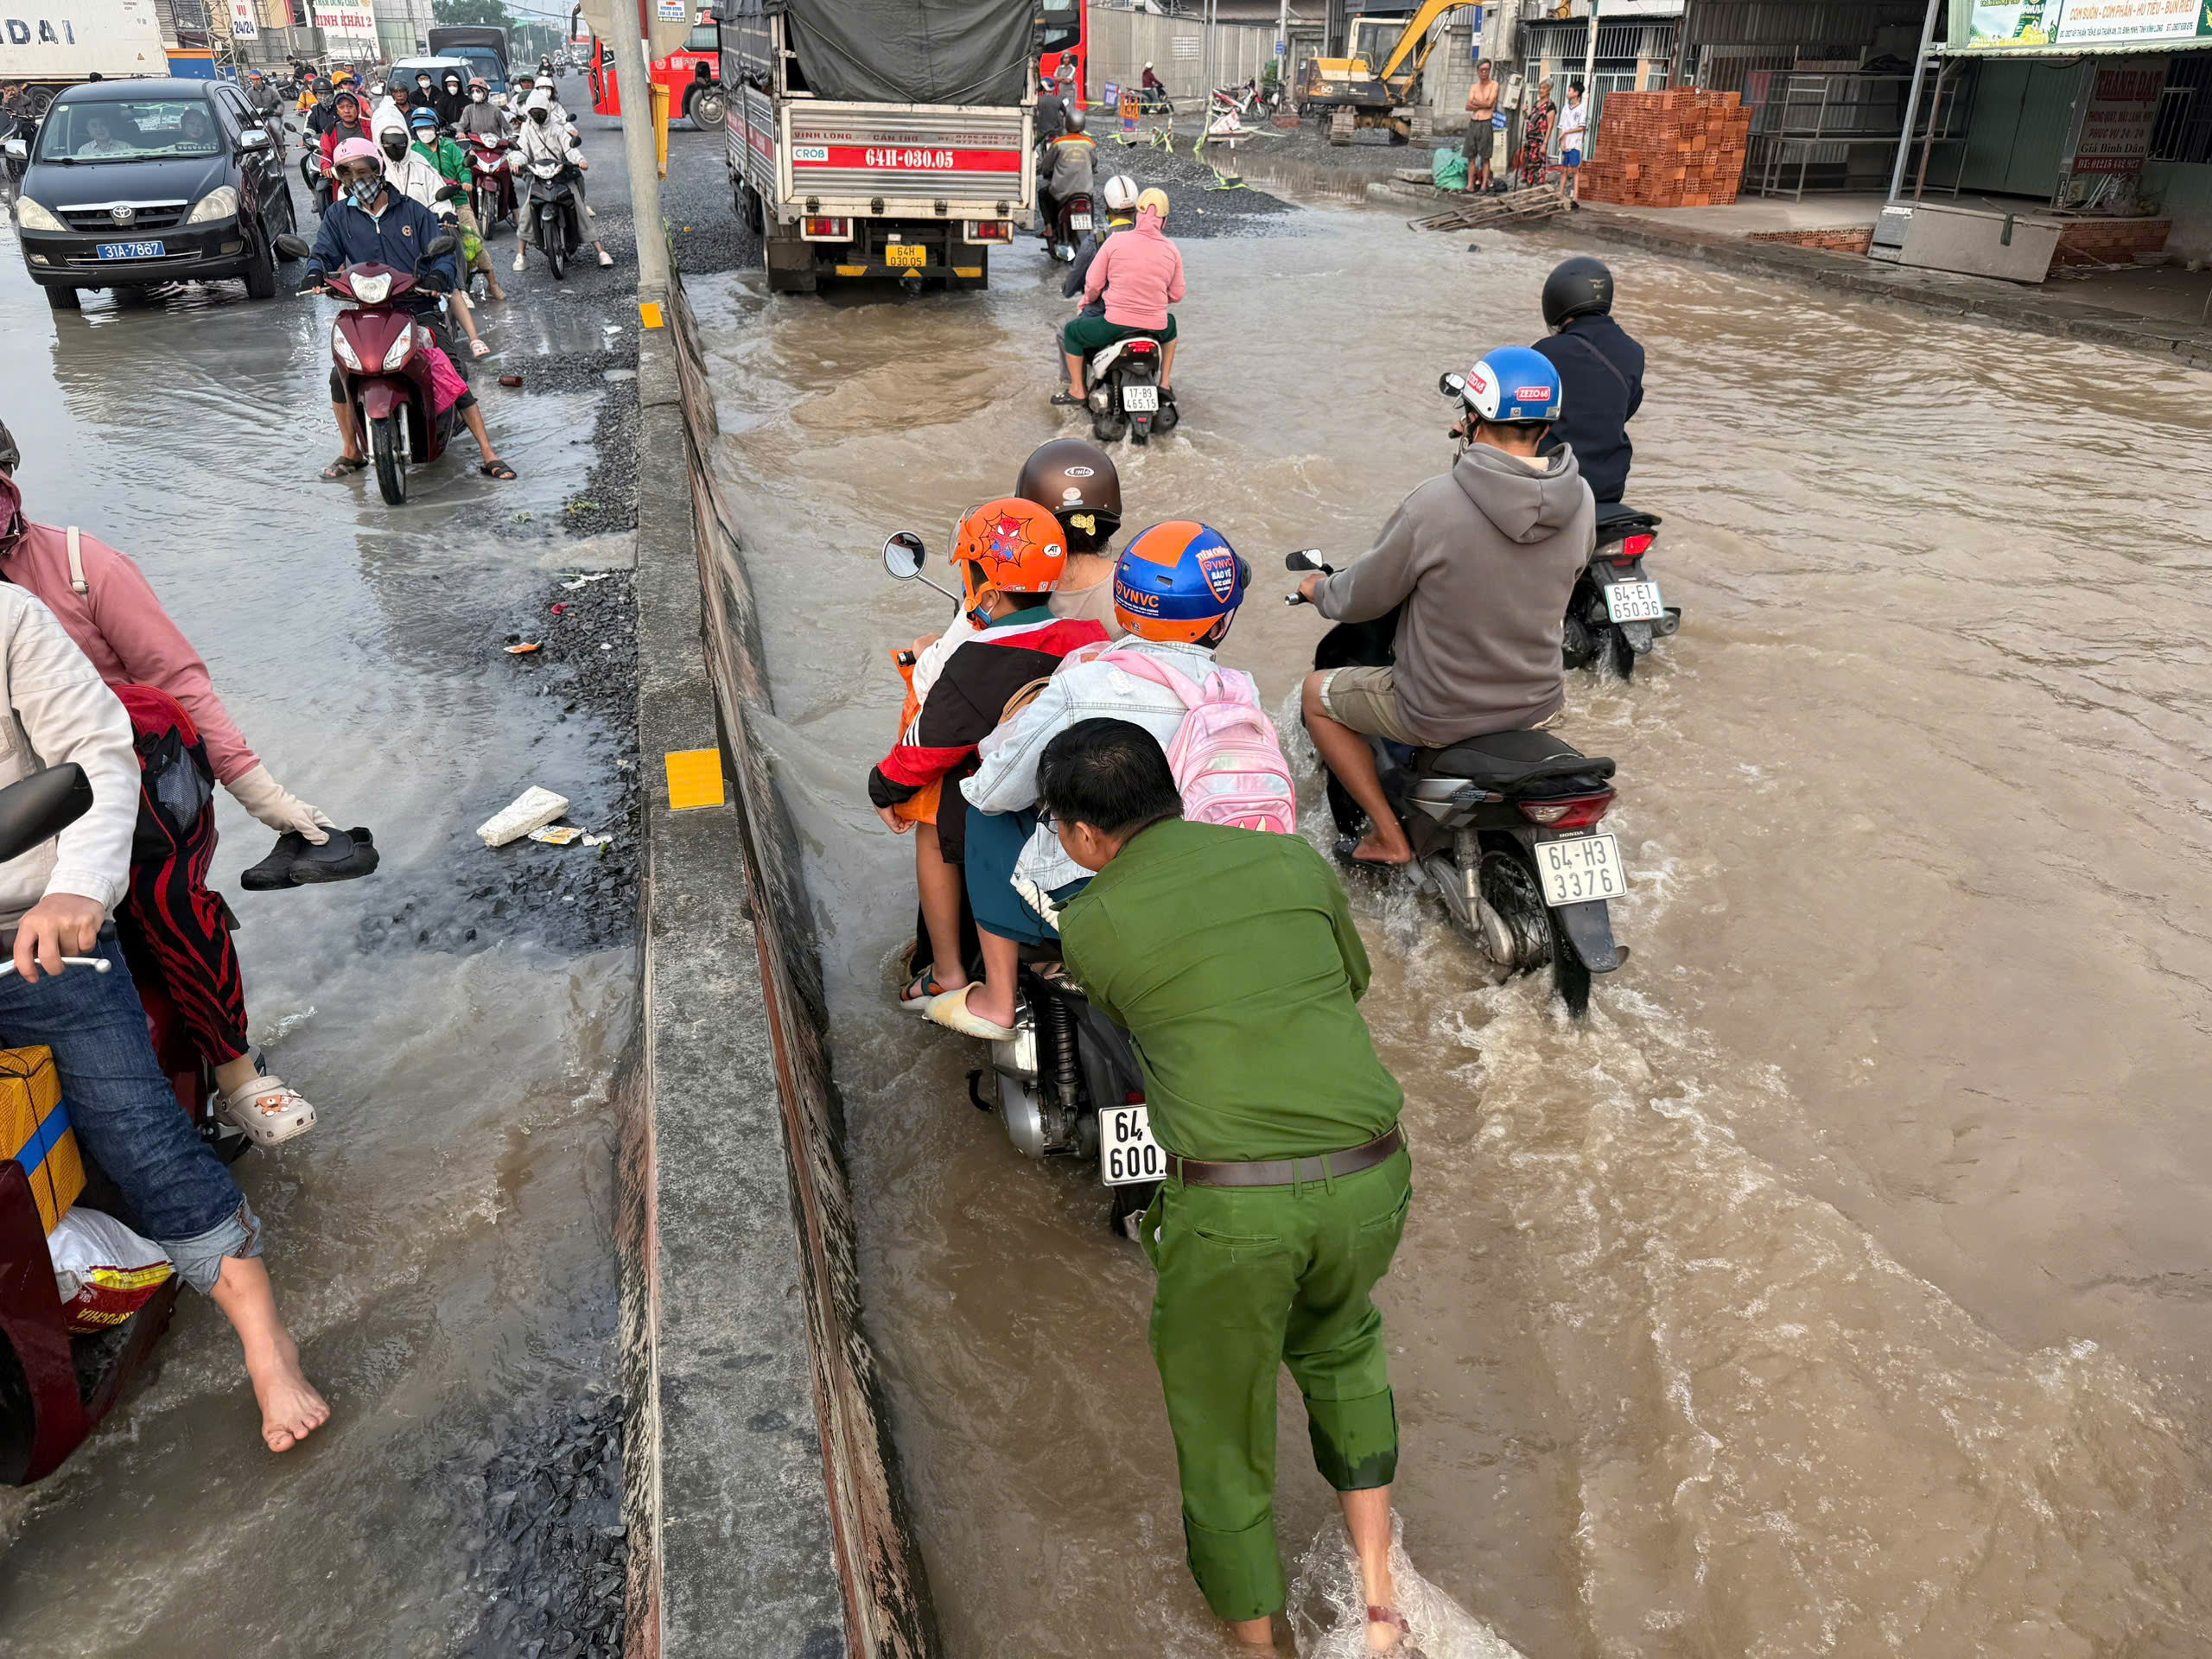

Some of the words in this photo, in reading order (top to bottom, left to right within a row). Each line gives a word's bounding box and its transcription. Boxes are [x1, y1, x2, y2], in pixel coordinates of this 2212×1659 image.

[236, 4, 247, 18] VỤ
[234, 21, 255, 35] 24/24
[366, 16, 373, 27] 2
[865, 148, 954, 168] 64H-030.05
[105, 243, 159, 258] 31A-7867
[897, 247, 915, 257] 64H
[890, 257, 922, 267] 030.05
[1518, 390, 1540, 398] ZEZO
[1126, 398, 1157, 409] 465.15
[1211, 557, 1232, 569] VNVC
[1123, 586, 1160, 608] VNVC
[1613, 584, 1651, 601] 64-E1
[1613, 601, 1659, 619] 650.36
[1548, 840, 1607, 871] 64-H3
[1554, 868, 1613, 899] 3376
